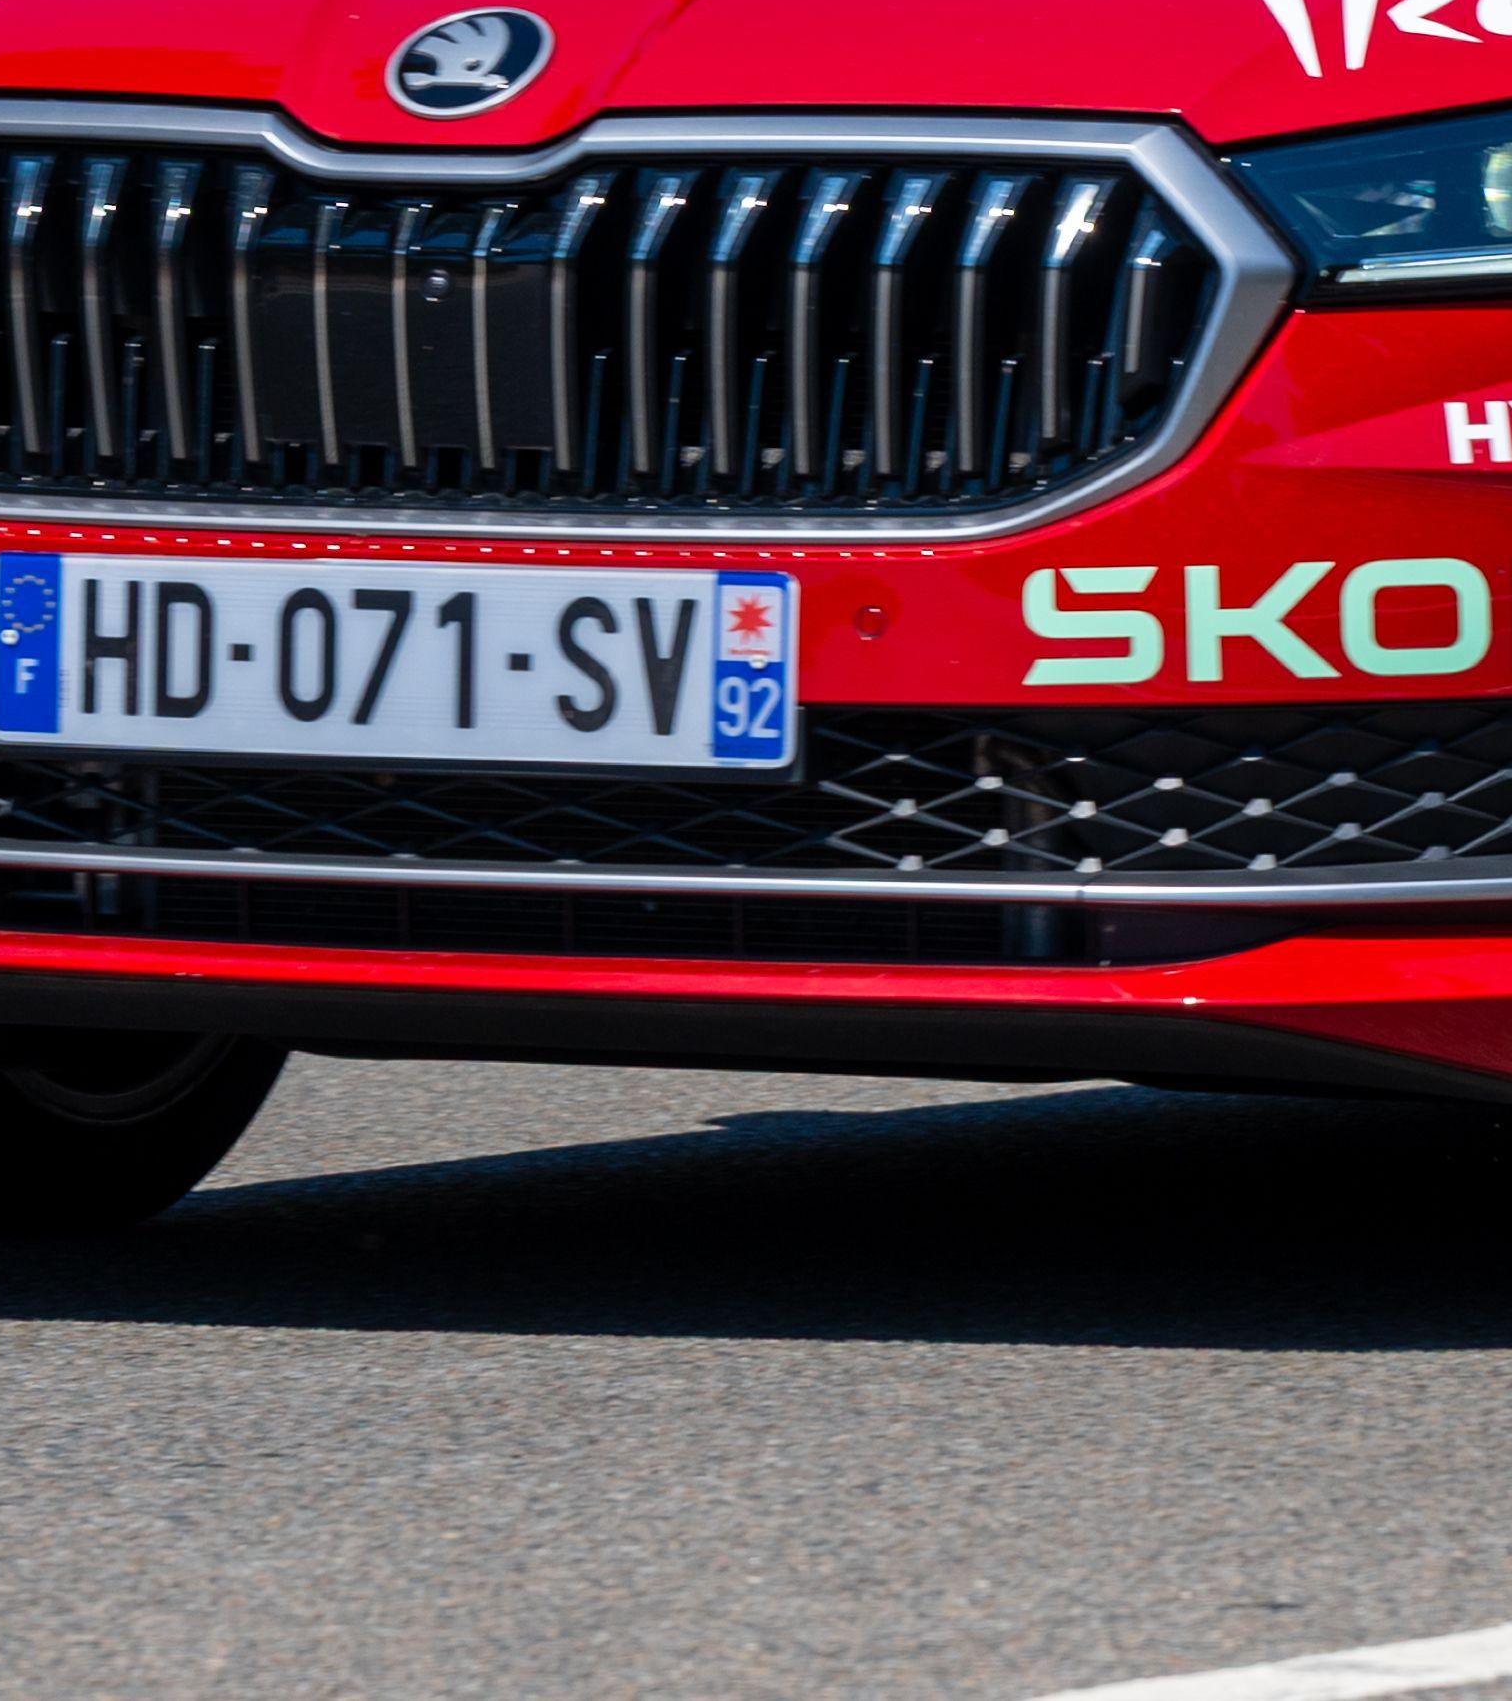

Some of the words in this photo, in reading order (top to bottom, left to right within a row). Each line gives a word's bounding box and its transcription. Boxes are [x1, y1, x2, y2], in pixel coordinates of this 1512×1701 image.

[15, 658, 40, 695] F
[81, 577, 700, 736] HD-071-SV
[717, 676, 781, 739] 92
